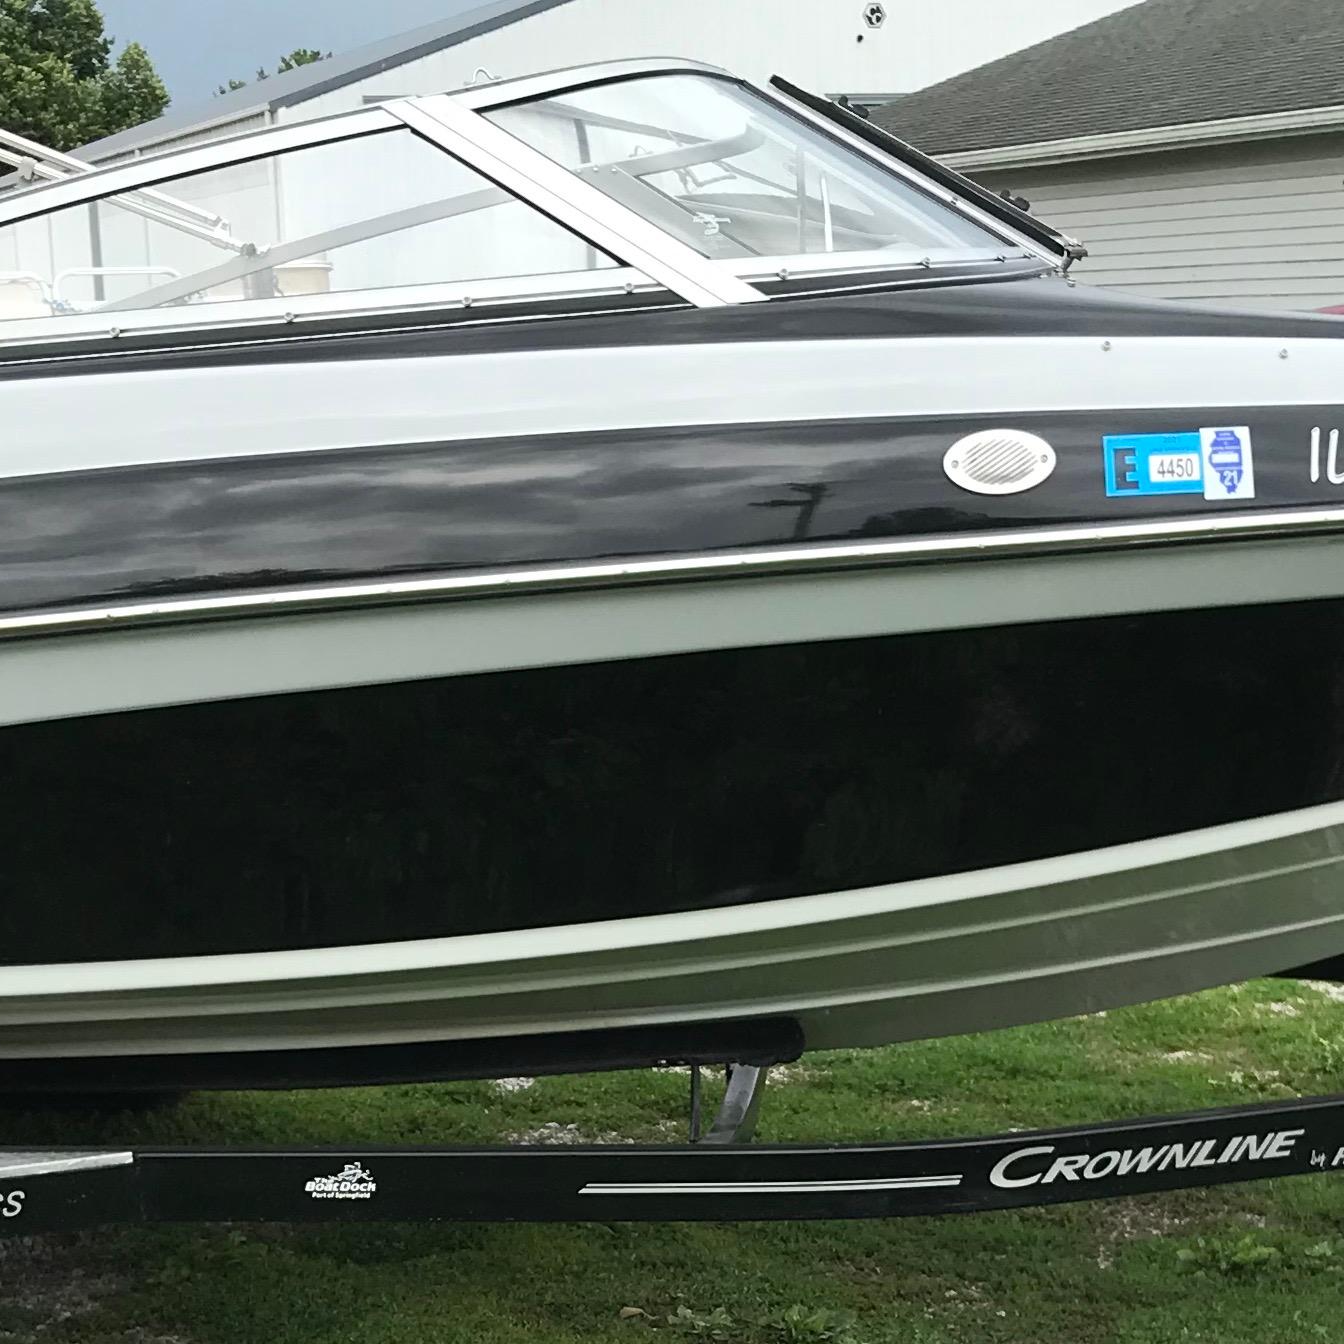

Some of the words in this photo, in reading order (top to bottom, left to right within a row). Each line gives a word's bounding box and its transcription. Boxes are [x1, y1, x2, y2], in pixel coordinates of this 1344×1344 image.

[1113, 448, 1140, 490] E
[1157, 458, 1194, 478] 4450
[1223, 470, 1238, 486] 21
[1310, 1149, 1327, 1169] by
